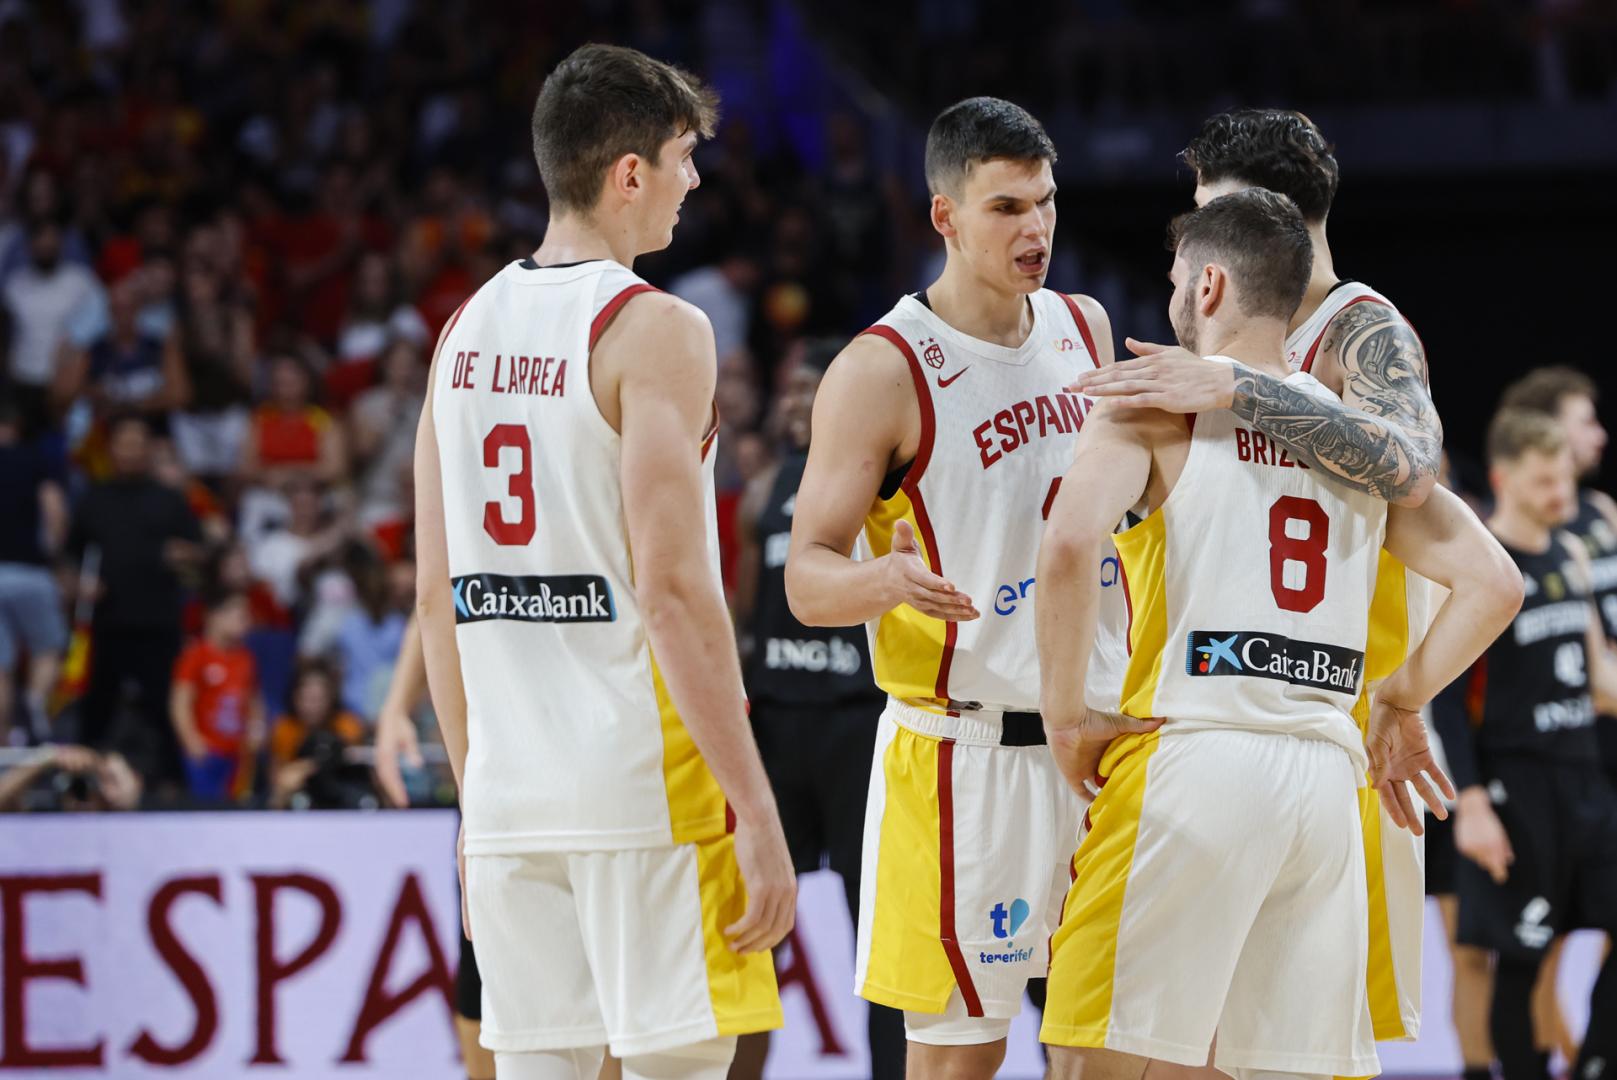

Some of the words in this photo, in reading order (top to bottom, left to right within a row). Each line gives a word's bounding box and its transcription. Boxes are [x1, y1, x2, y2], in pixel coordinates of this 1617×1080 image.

[451, 351, 480, 390] DE
[491, 354, 568, 398] LARREA
[972, 386, 1094, 470] ESPAÑ
[1235, 427, 1311, 470] BRIZ
[483, 423, 537, 546] 3
[1268, 494, 1330, 614] 8
[465, 578, 610, 618] CaixaBank
